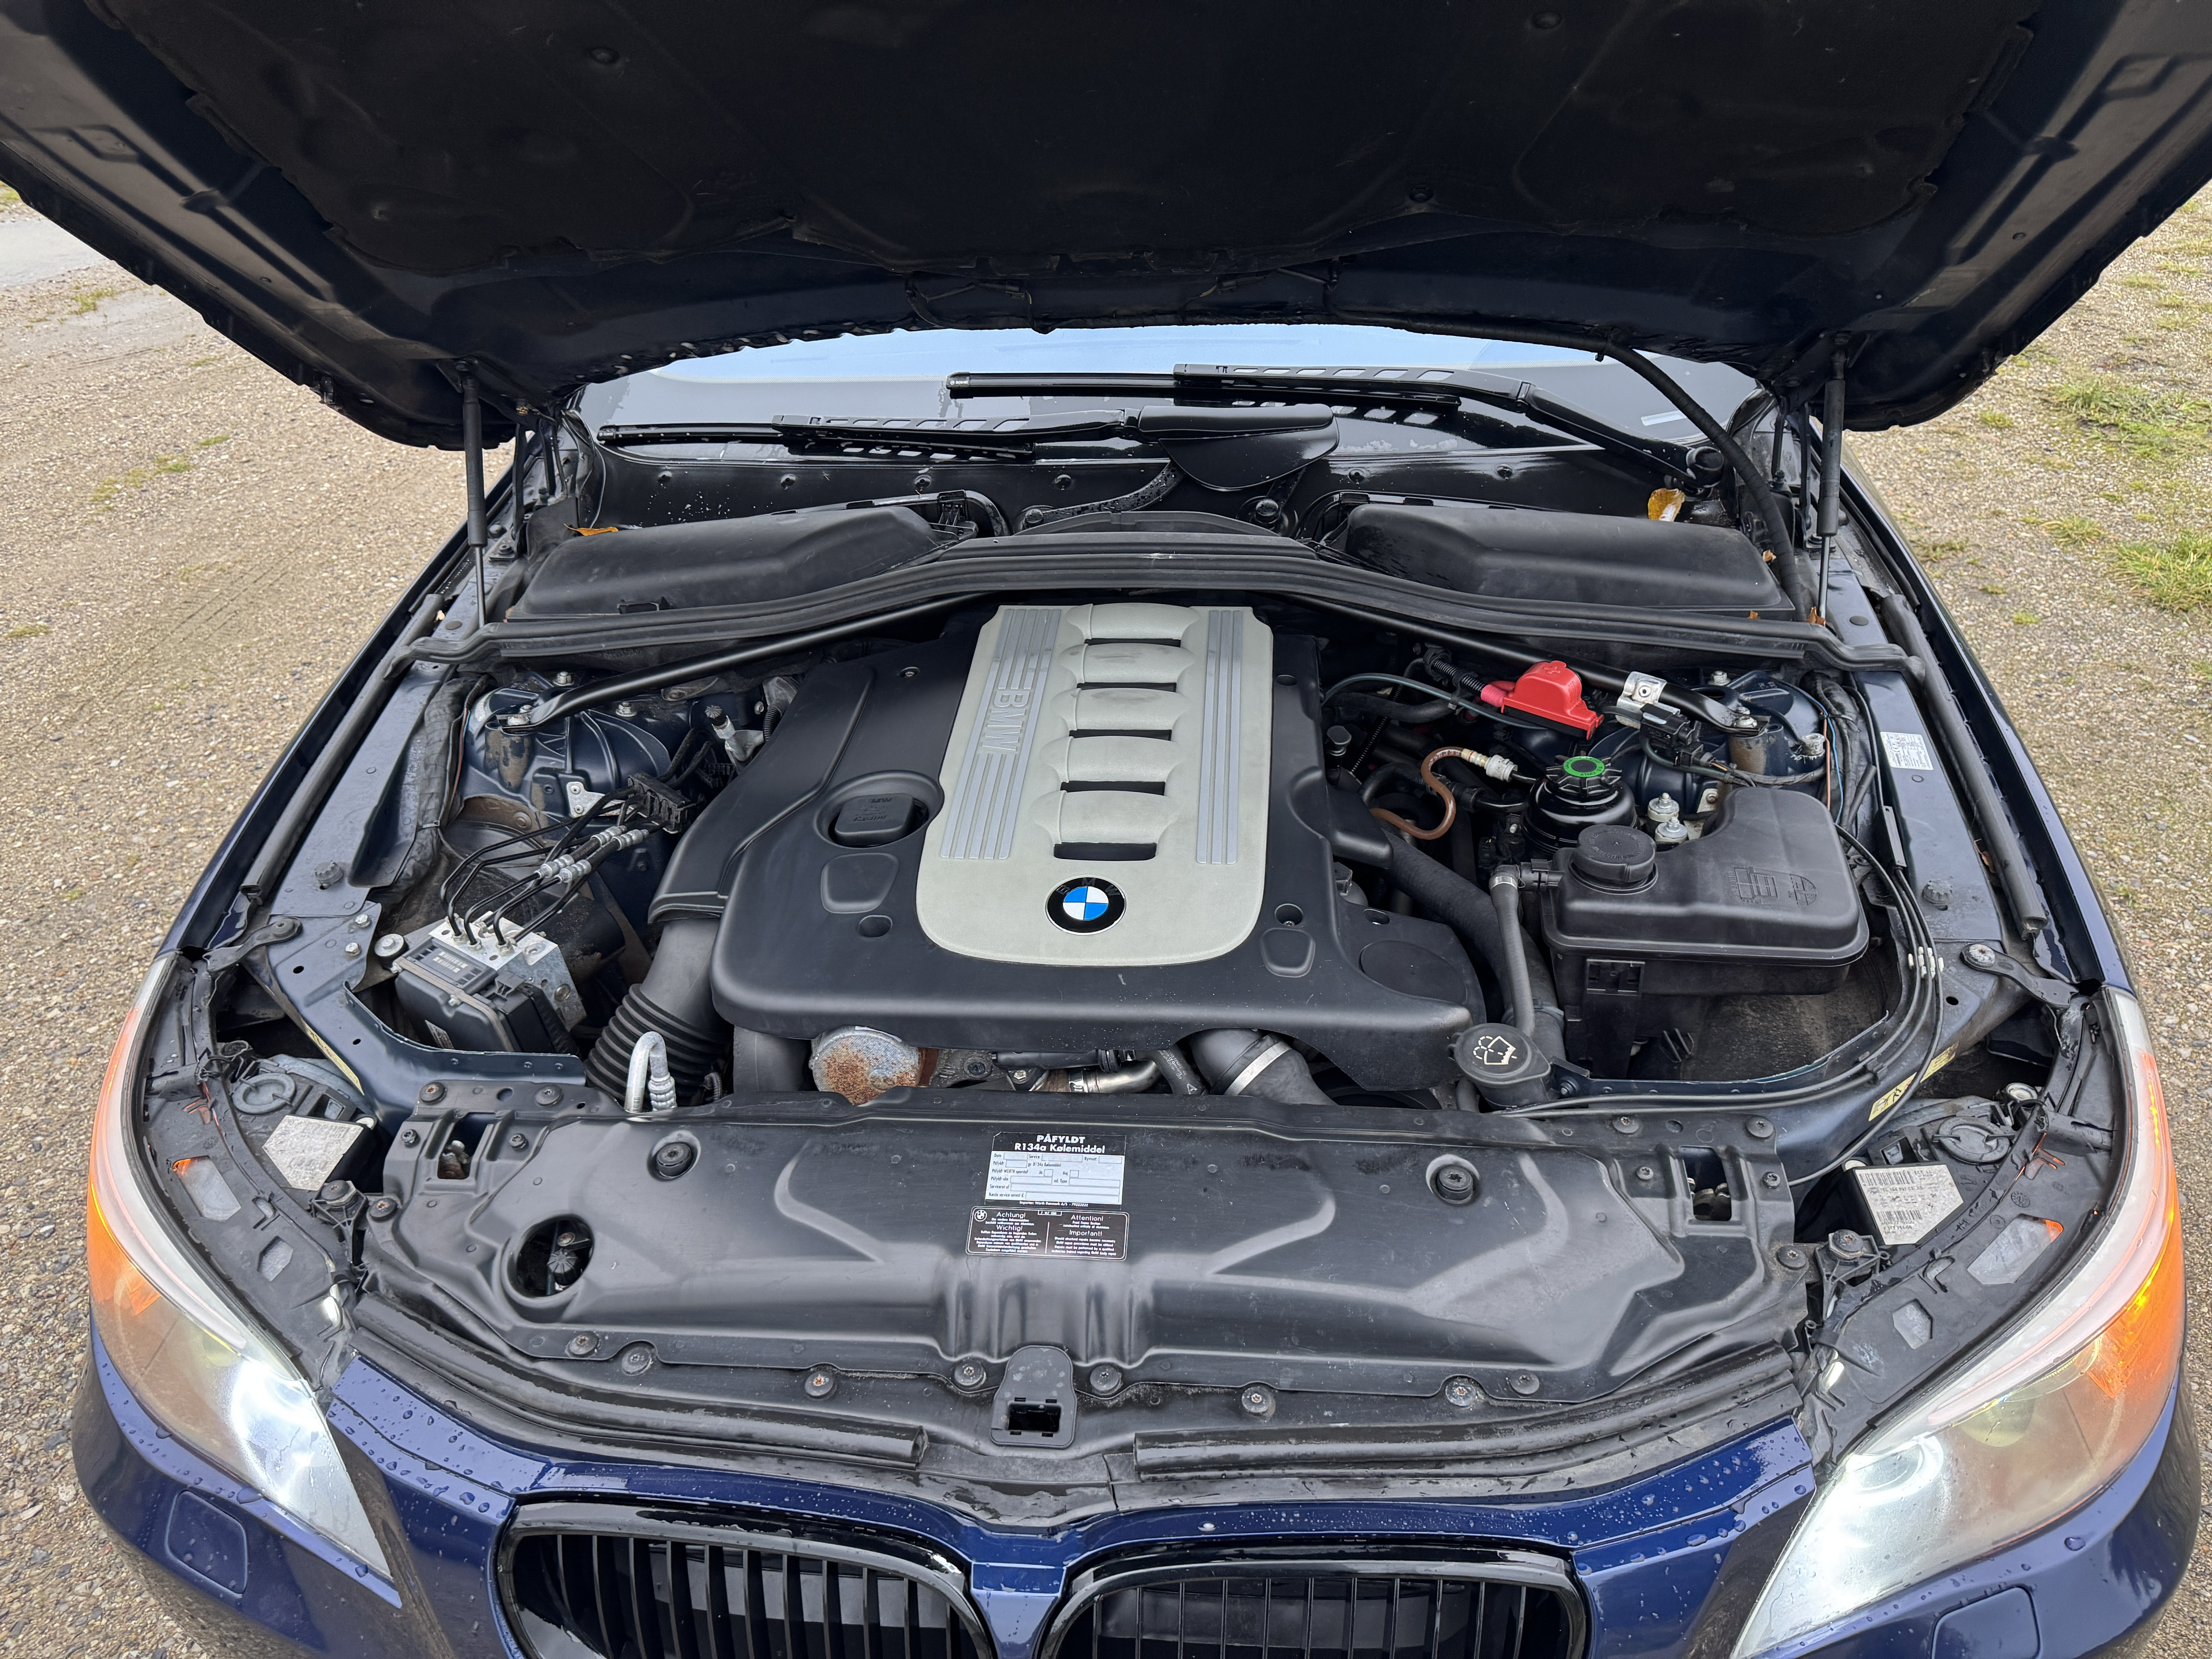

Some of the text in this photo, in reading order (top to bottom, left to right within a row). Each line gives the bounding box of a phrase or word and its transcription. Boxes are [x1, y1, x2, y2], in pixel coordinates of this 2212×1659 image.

[982, 690, 1030, 751] BMW
[1056, 878, 1120, 896] BMW
[1036, 1133, 1085, 1144] PÅFYLDT
[1015, 1143, 1105, 1153] R134a Kølemiddel
